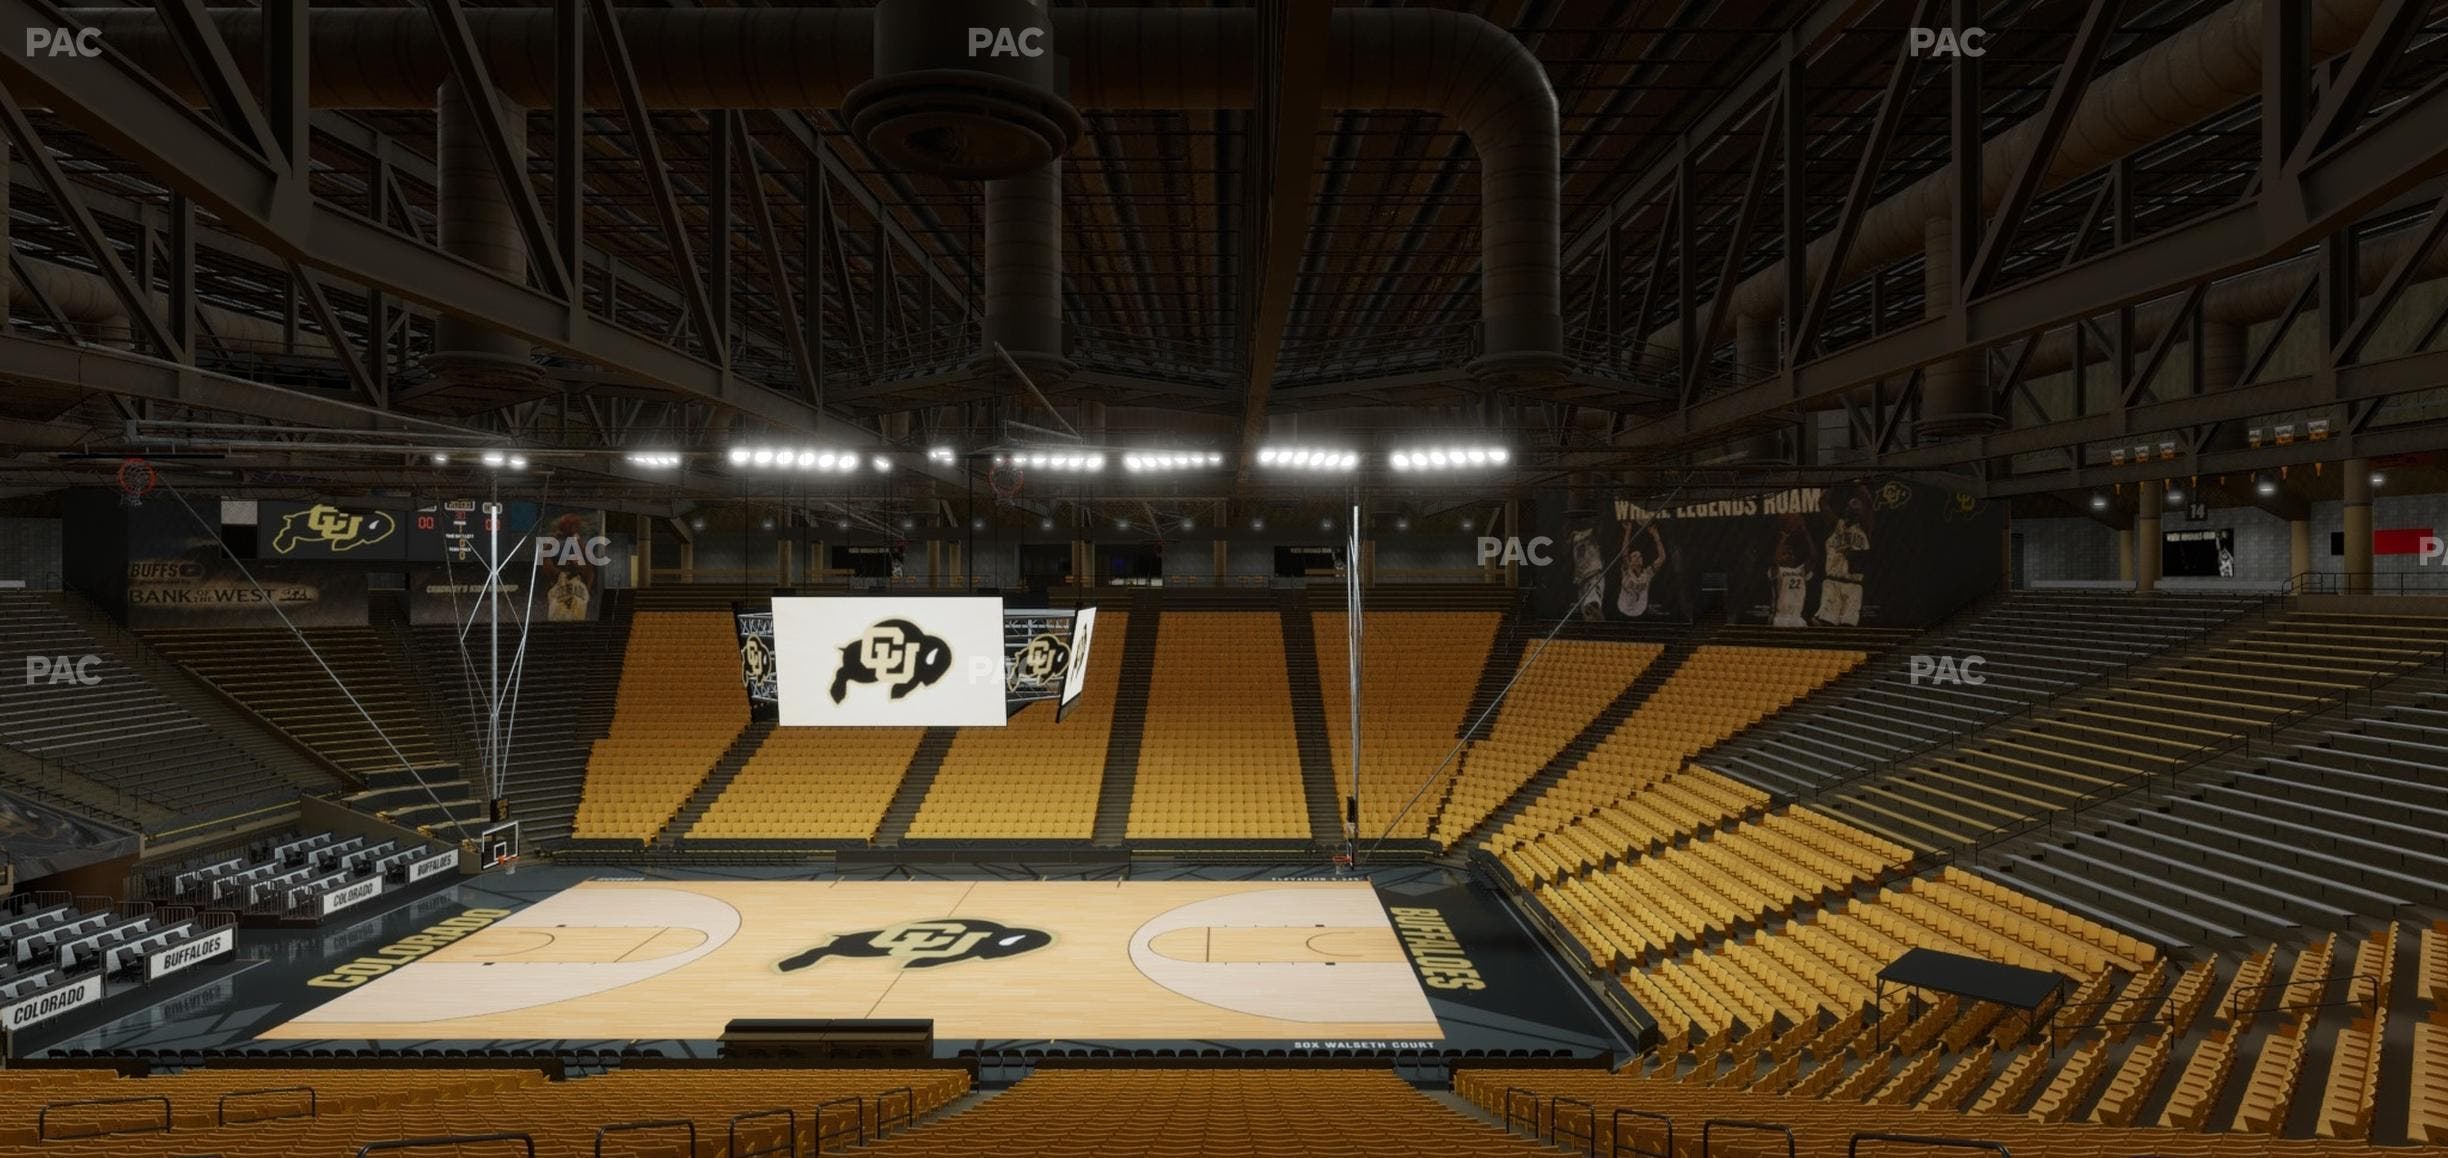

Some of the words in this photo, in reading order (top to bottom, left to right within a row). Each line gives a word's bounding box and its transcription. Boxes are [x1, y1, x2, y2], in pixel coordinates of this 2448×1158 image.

[2190, 503, 2205, 519] 14
[130, 563, 178, 577] BUFFS
[129, 589, 192, 603] BANK
[214, 589, 275, 603] WEST
[333, 882, 373, 907] COLORADO
[163, 937, 221, 970] BUFFALOES
[306, 907, 512, 989] COLORADO
[1389, 906, 1487, 990] BUFFALOES
[14, 985, 85, 1025] COLORADO
[1293, 1041, 1320, 1049] SOX
[1325, 1041, 1386, 1049] WALSETH
[1392, 1041, 1435, 1049] COURT
